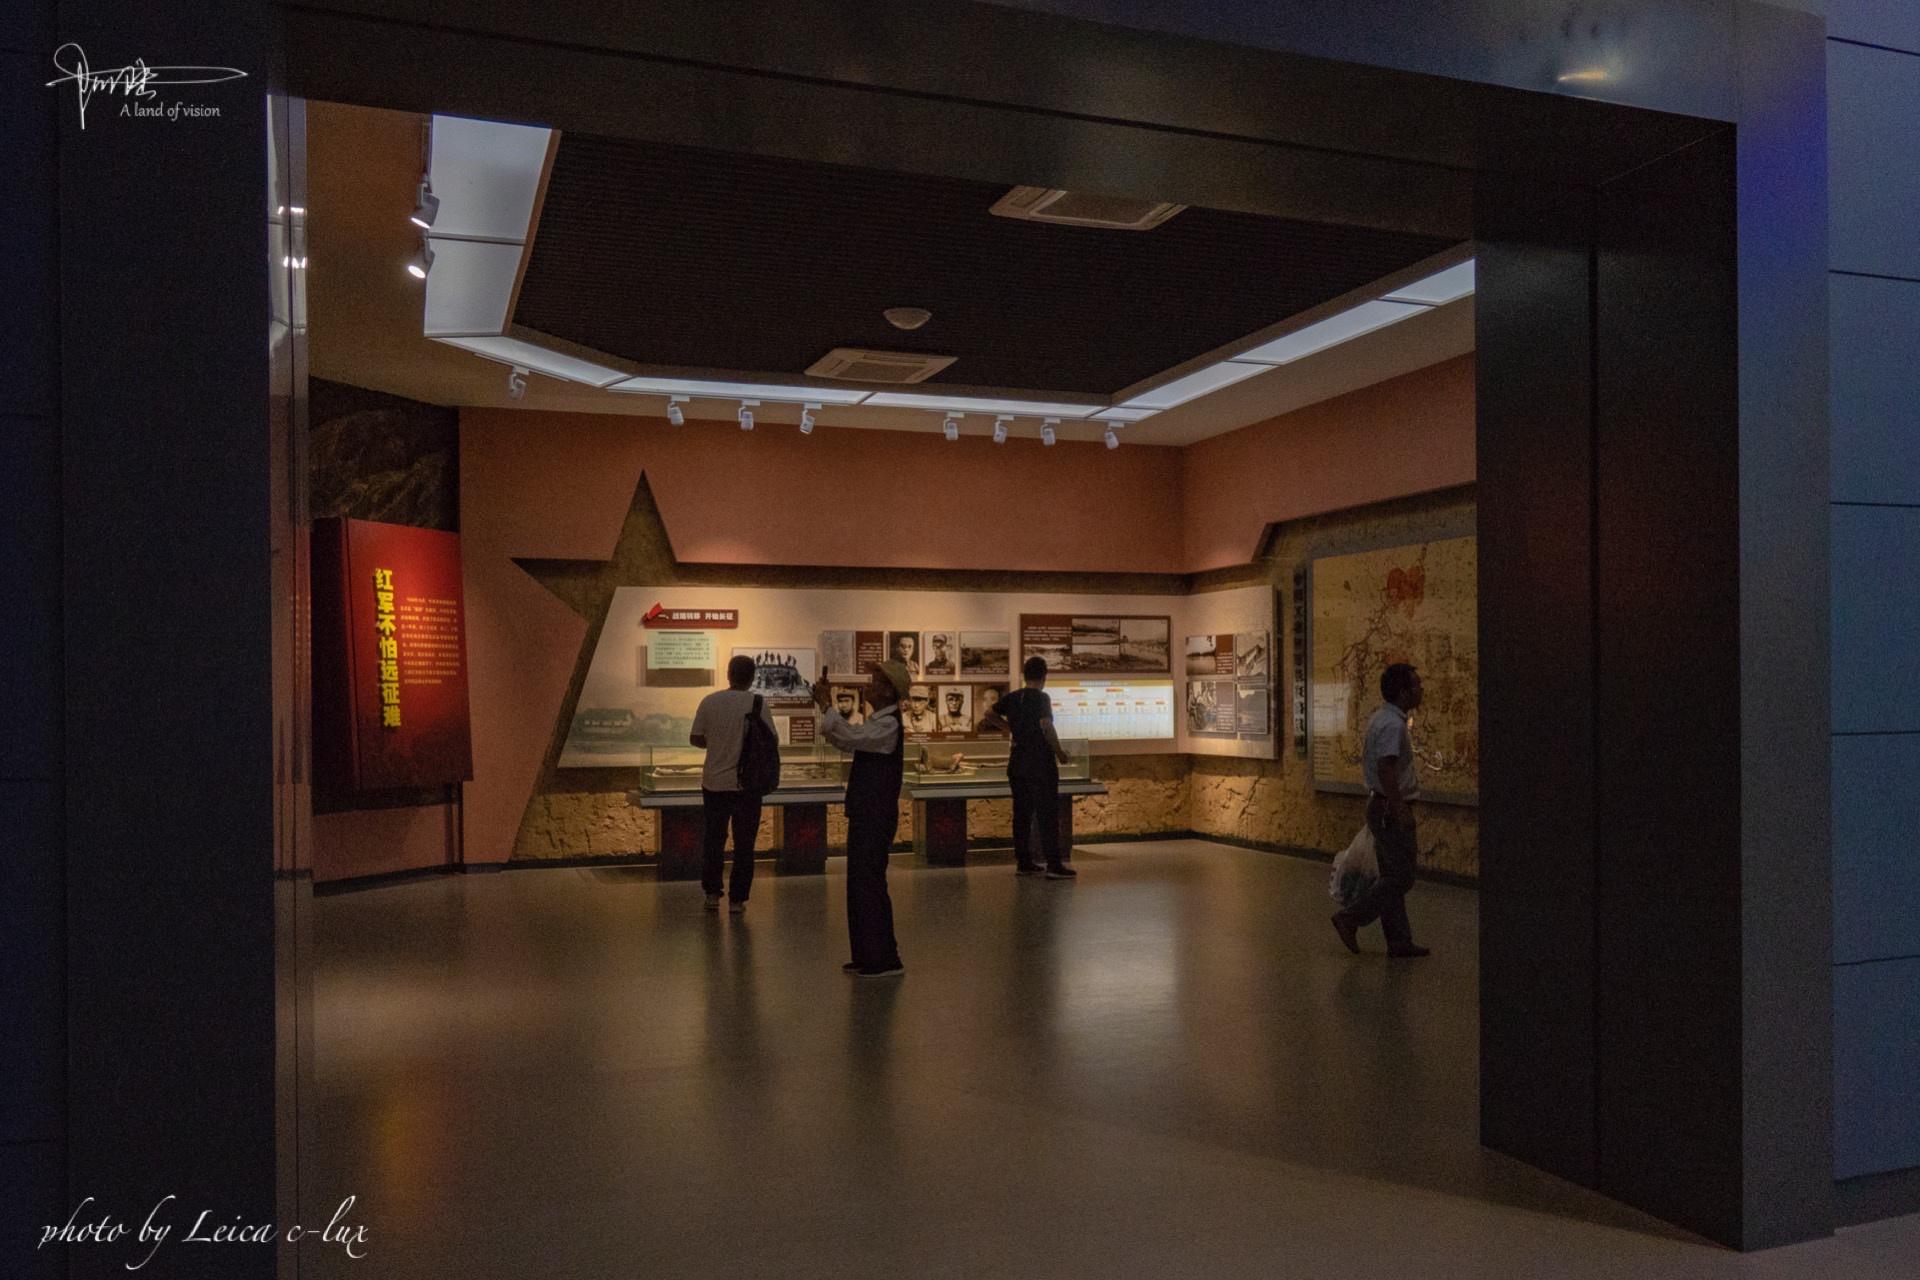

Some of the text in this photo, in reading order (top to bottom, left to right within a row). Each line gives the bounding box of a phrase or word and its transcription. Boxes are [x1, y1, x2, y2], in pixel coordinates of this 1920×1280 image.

[374, 567, 403, 727] 红军不怕远征难
